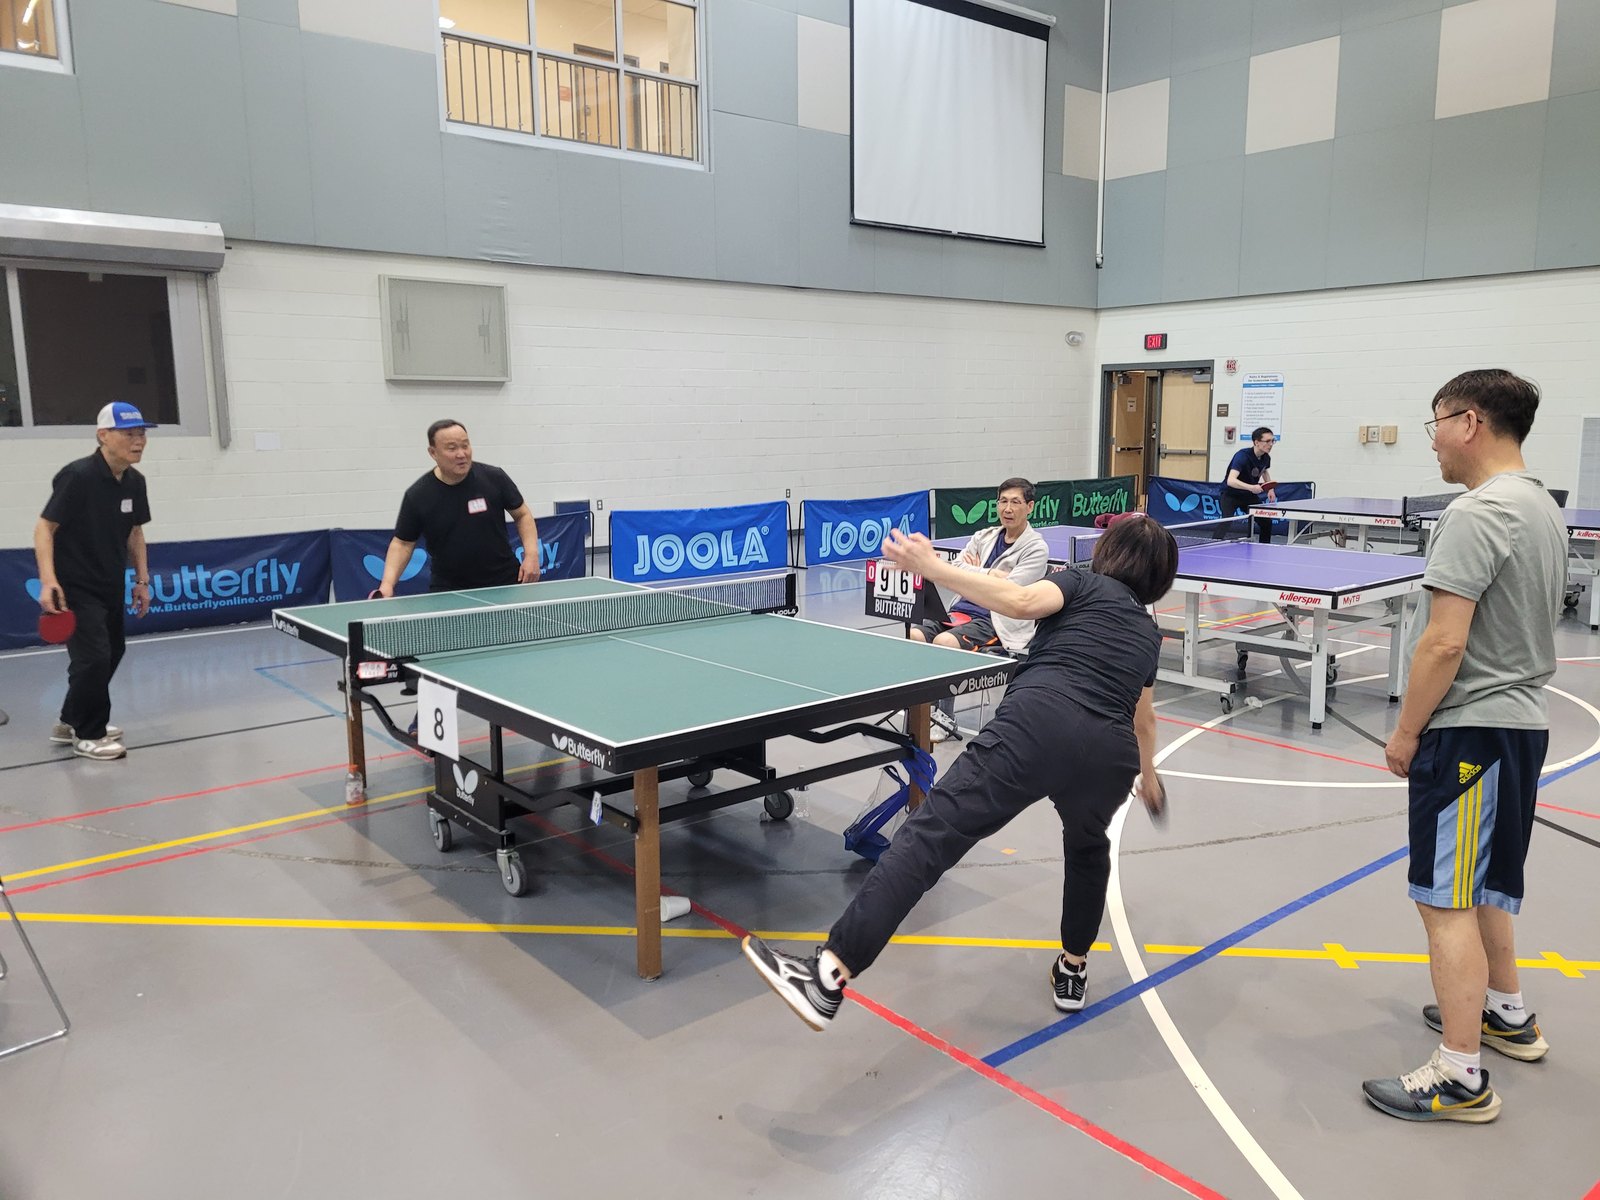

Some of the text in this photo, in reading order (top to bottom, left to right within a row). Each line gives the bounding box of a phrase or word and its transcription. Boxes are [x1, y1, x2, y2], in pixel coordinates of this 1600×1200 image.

[1146, 335, 1162, 349] EXIT
[1072, 488, 1129, 518] Butterfly
[868, 565, 875, 580] 0
[880, 567, 889, 592] 9
[900, 570, 909, 595] 6
[875, 598, 913, 619] BUTTERFLY
[1279, 592, 1321, 605] killerspin
[1342, 594, 1360, 605] MyT9
[968, 671, 1008, 692] Butterfly
[433, 707, 445, 741] 8
[567, 738, 605, 770] Butterfly
[1459, 764, 1482, 784] adidas
